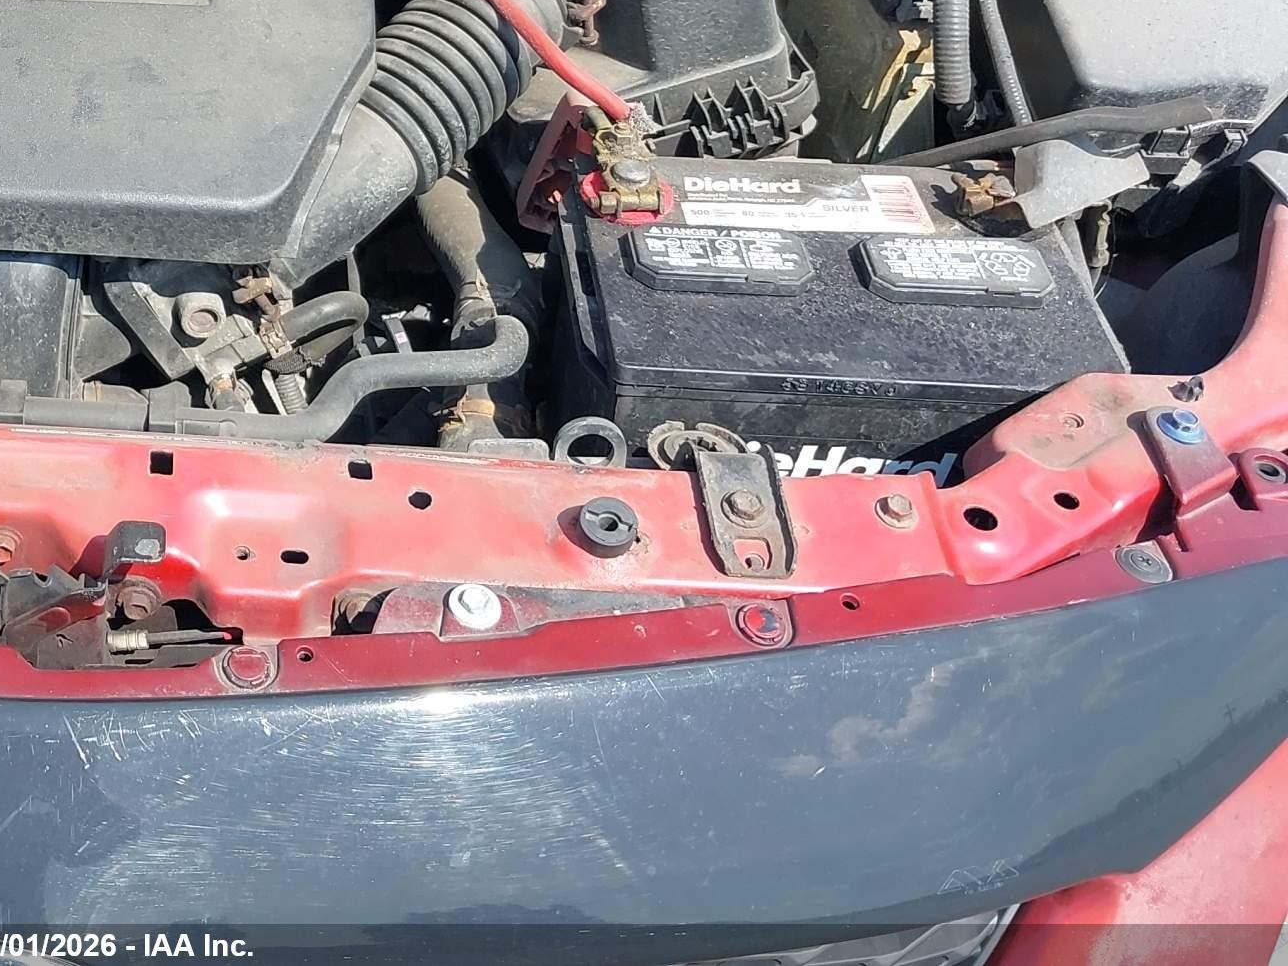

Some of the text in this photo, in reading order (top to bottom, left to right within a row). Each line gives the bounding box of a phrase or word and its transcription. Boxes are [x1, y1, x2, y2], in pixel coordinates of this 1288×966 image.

[683, 176, 802, 195] DieHard
[822, 203, 870, 213] SILVER
[662, 226, 717, 237] DANGER
[730, 230, 782, 239] POISON
